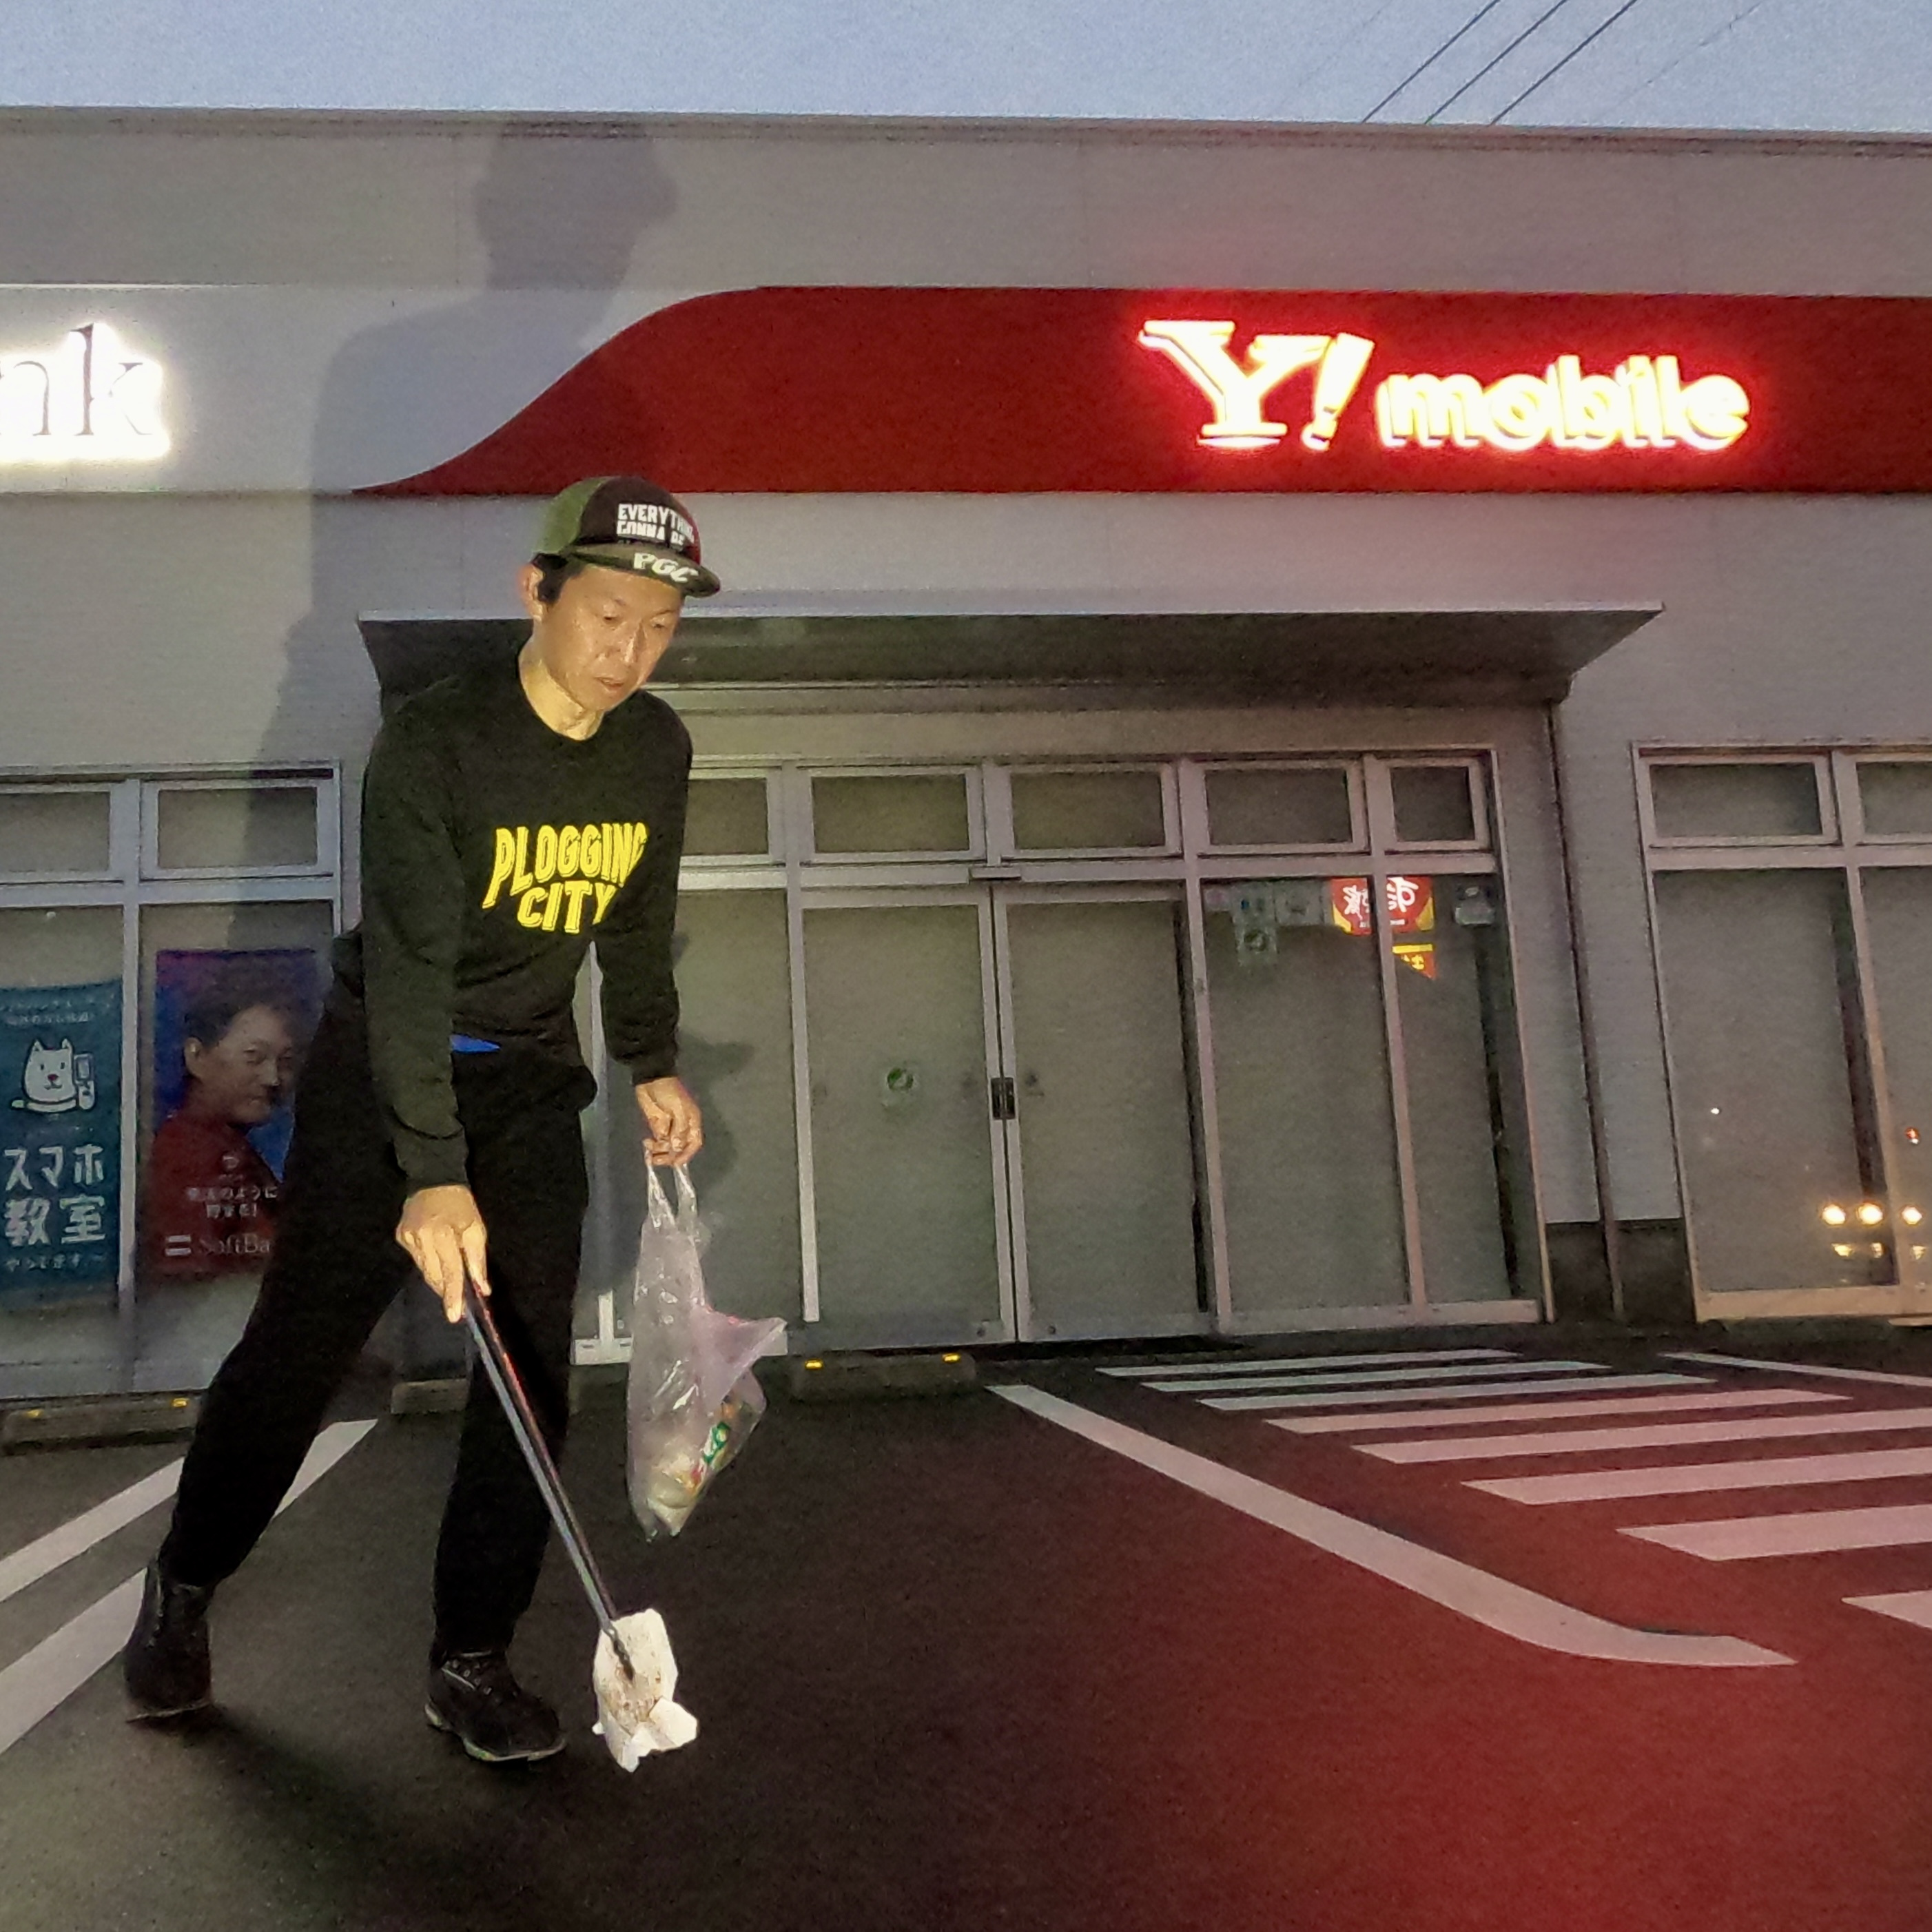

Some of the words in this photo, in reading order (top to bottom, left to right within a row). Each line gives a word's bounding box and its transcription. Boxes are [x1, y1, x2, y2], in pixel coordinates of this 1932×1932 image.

[617, 520, 666, 541] GONNA
[633, 552, 699, 583] PGC
[517, 880, 618, 934] CITY
[4, 1143, 104, 1191] スマホ
[4, 1193, 105, 1246] 教室
